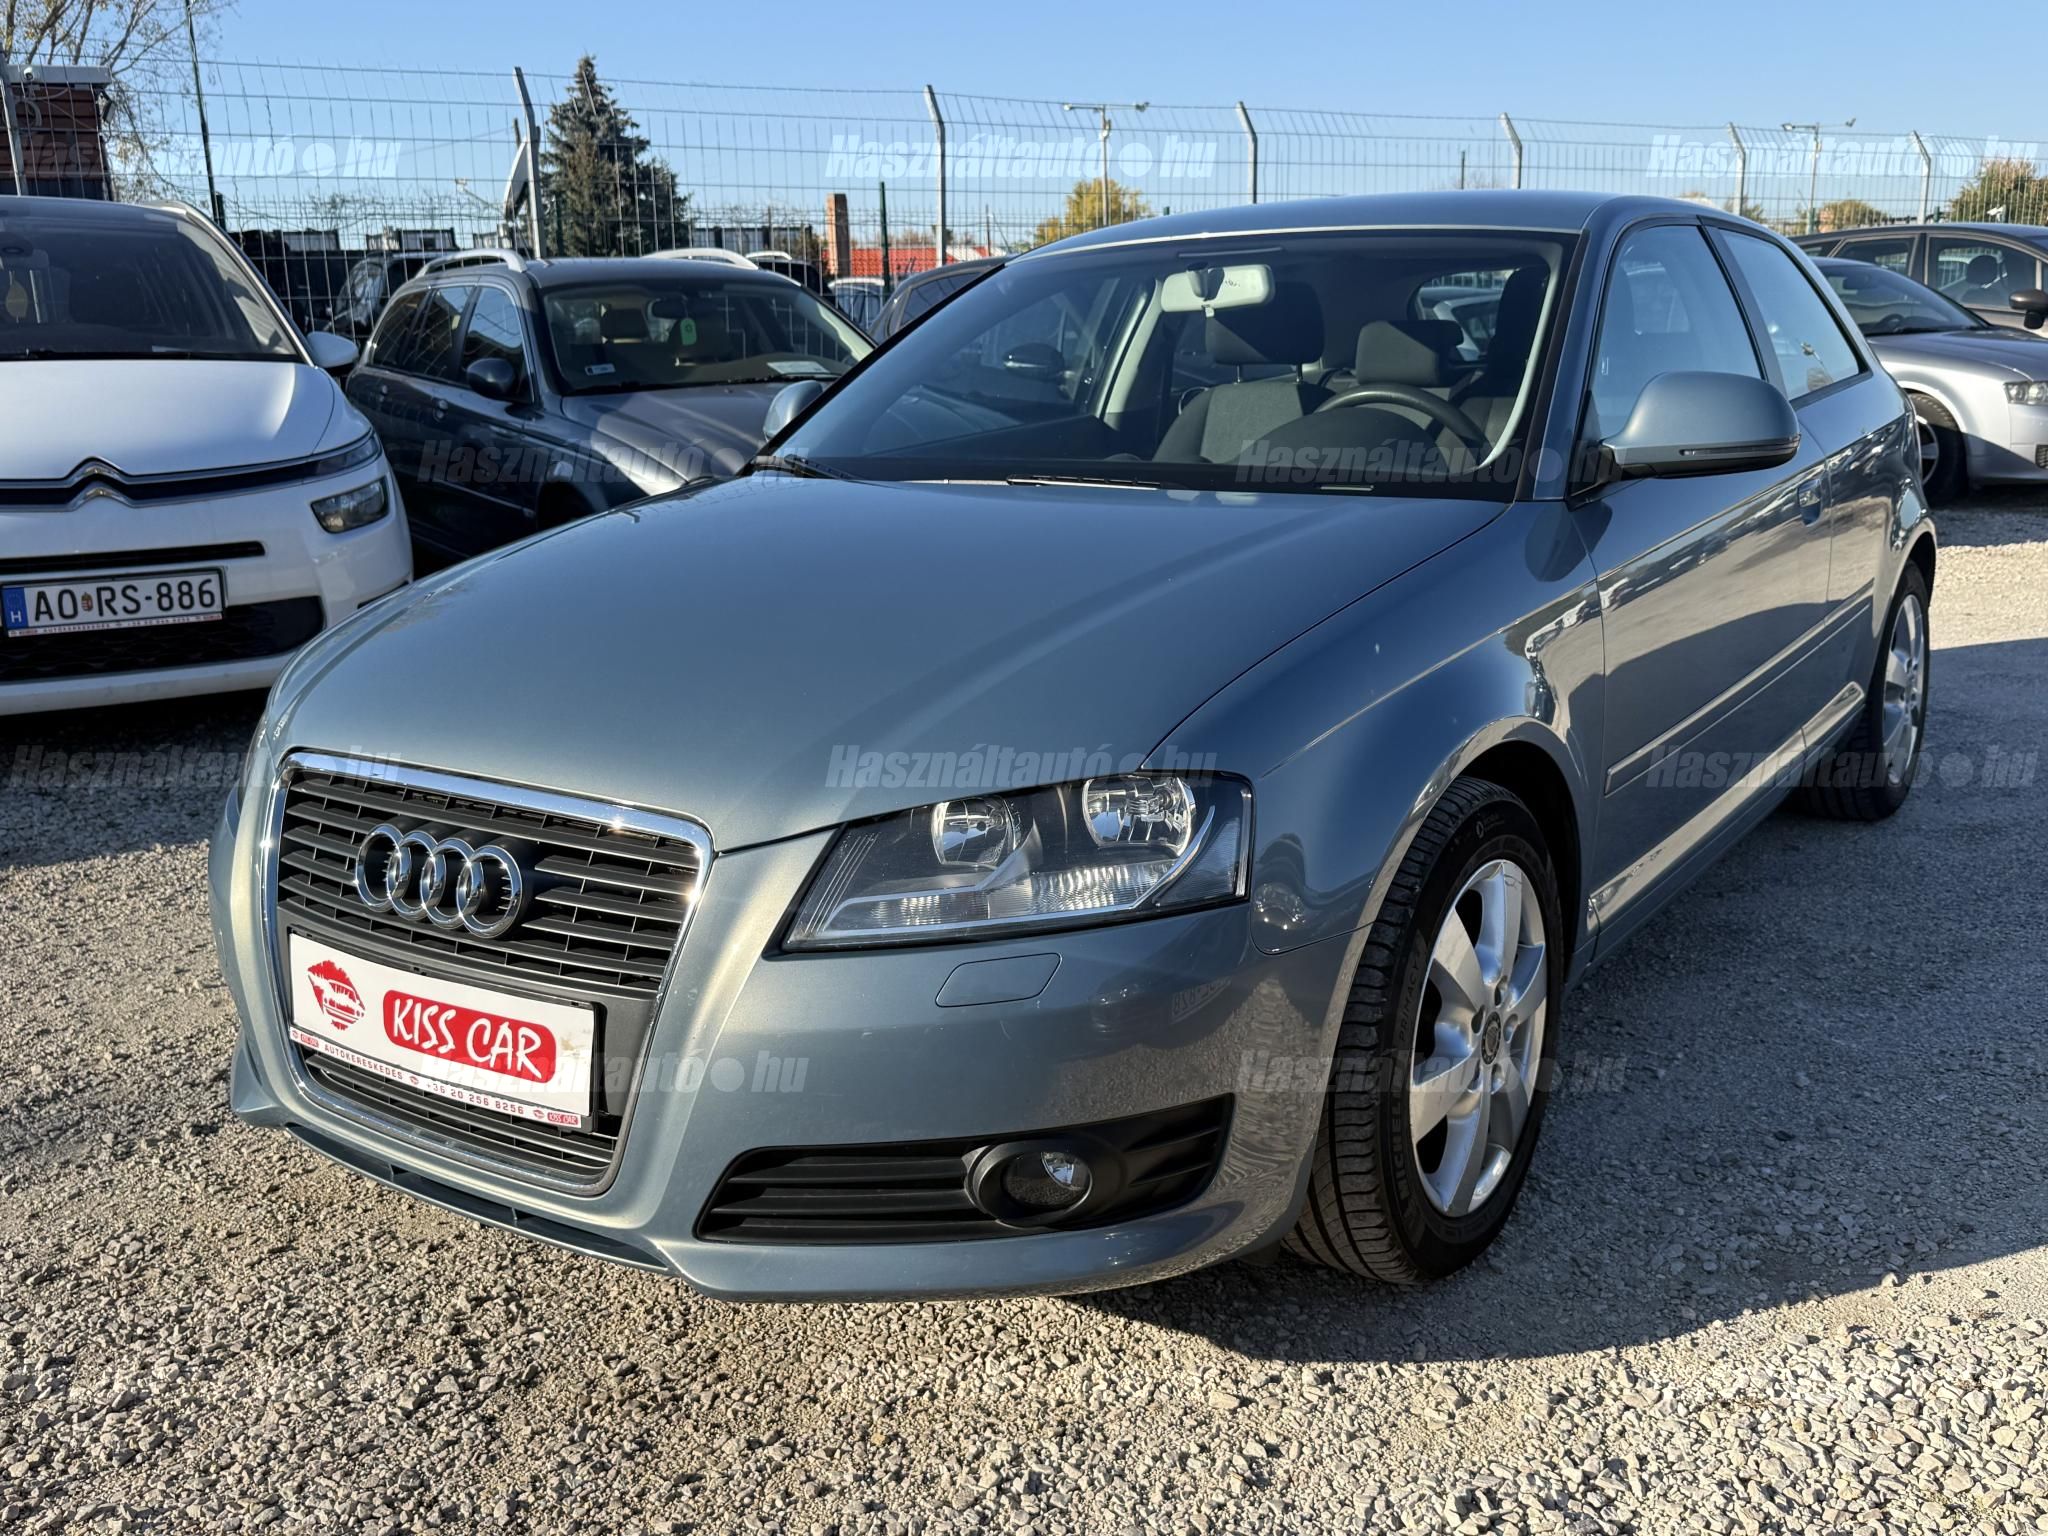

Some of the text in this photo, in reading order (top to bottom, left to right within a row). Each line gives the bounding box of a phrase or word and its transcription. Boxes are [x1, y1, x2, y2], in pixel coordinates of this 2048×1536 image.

[393, 998, 542, 1079] KISS CAR
[450, 1088, 464, 1099] 20
[468, 1093, 489, 1106] 256
[495, 1100, 524, 1115] 8256
